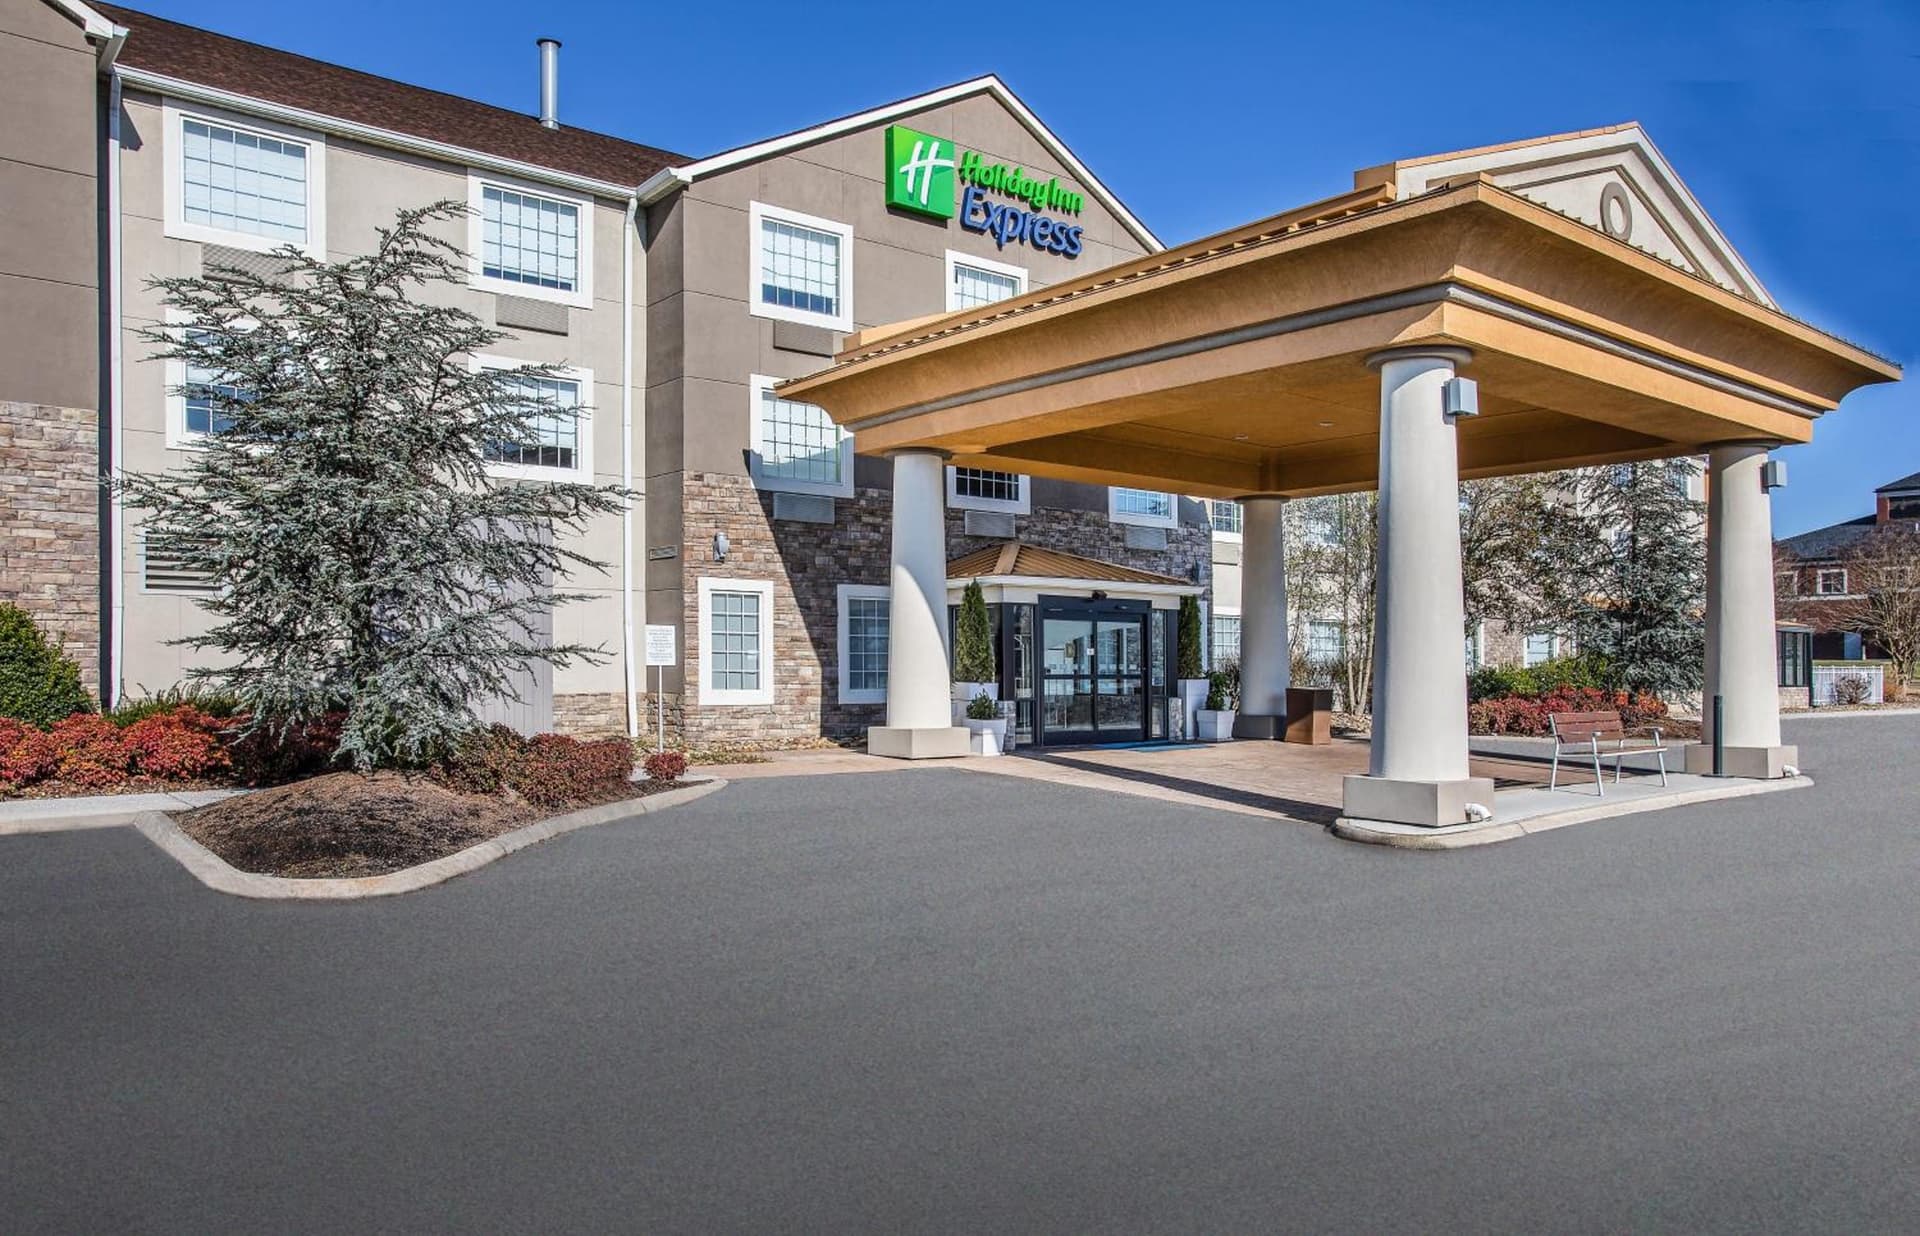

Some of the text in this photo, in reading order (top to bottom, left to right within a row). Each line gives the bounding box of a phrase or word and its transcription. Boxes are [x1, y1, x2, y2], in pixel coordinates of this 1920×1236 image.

[961, 150, 1084, 213] Holiday Inn
[961, 186, 1084, 255] Express
